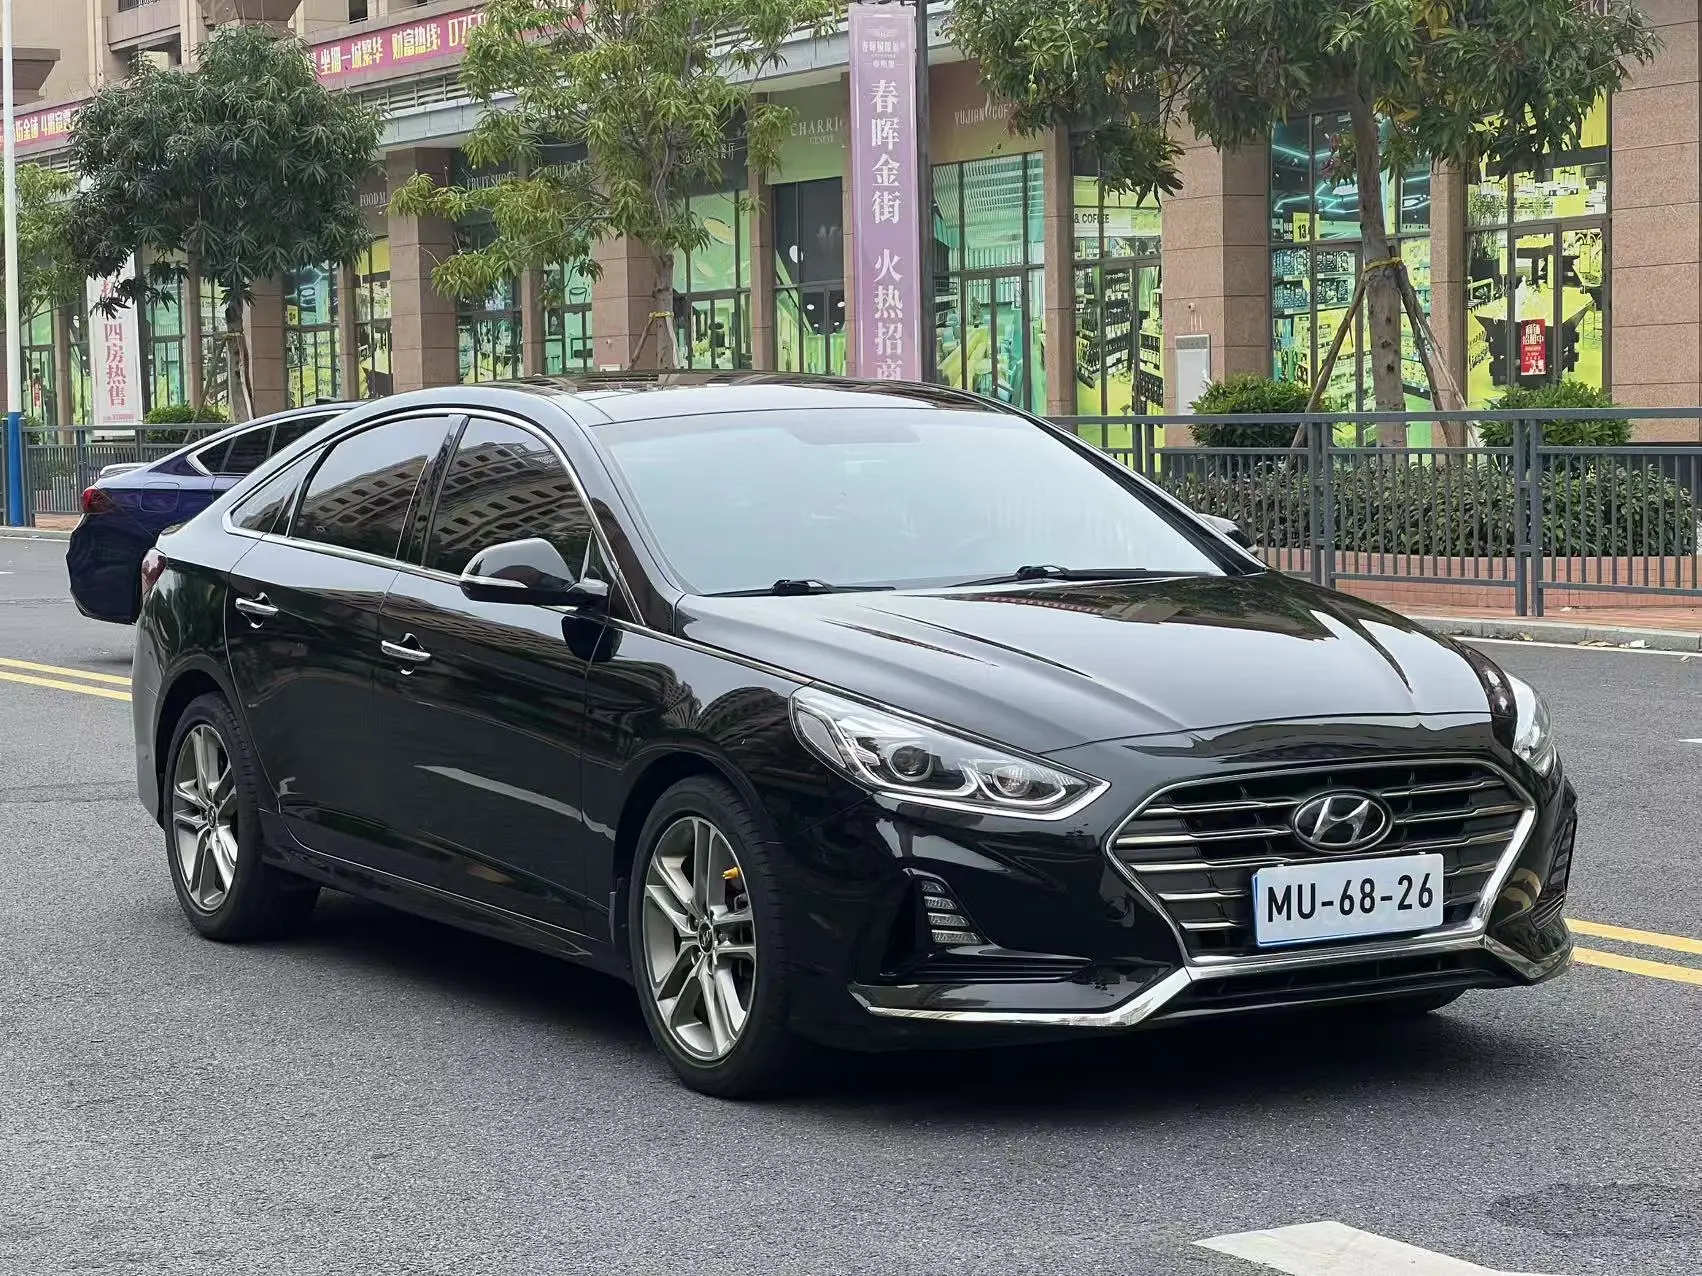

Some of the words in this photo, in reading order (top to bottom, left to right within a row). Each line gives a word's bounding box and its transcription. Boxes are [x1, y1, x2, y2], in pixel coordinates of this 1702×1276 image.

[870, 79, 901, 225] 春晖金街
[359, 193, 378, 207] FOOD
[1082, 213, 1110, 224] COFEE
[874, 248, 903, 381] 火热招商
[103, 322, 127, 407] 四房热售
[1267, 872, 1433, 922] MU-68-26
